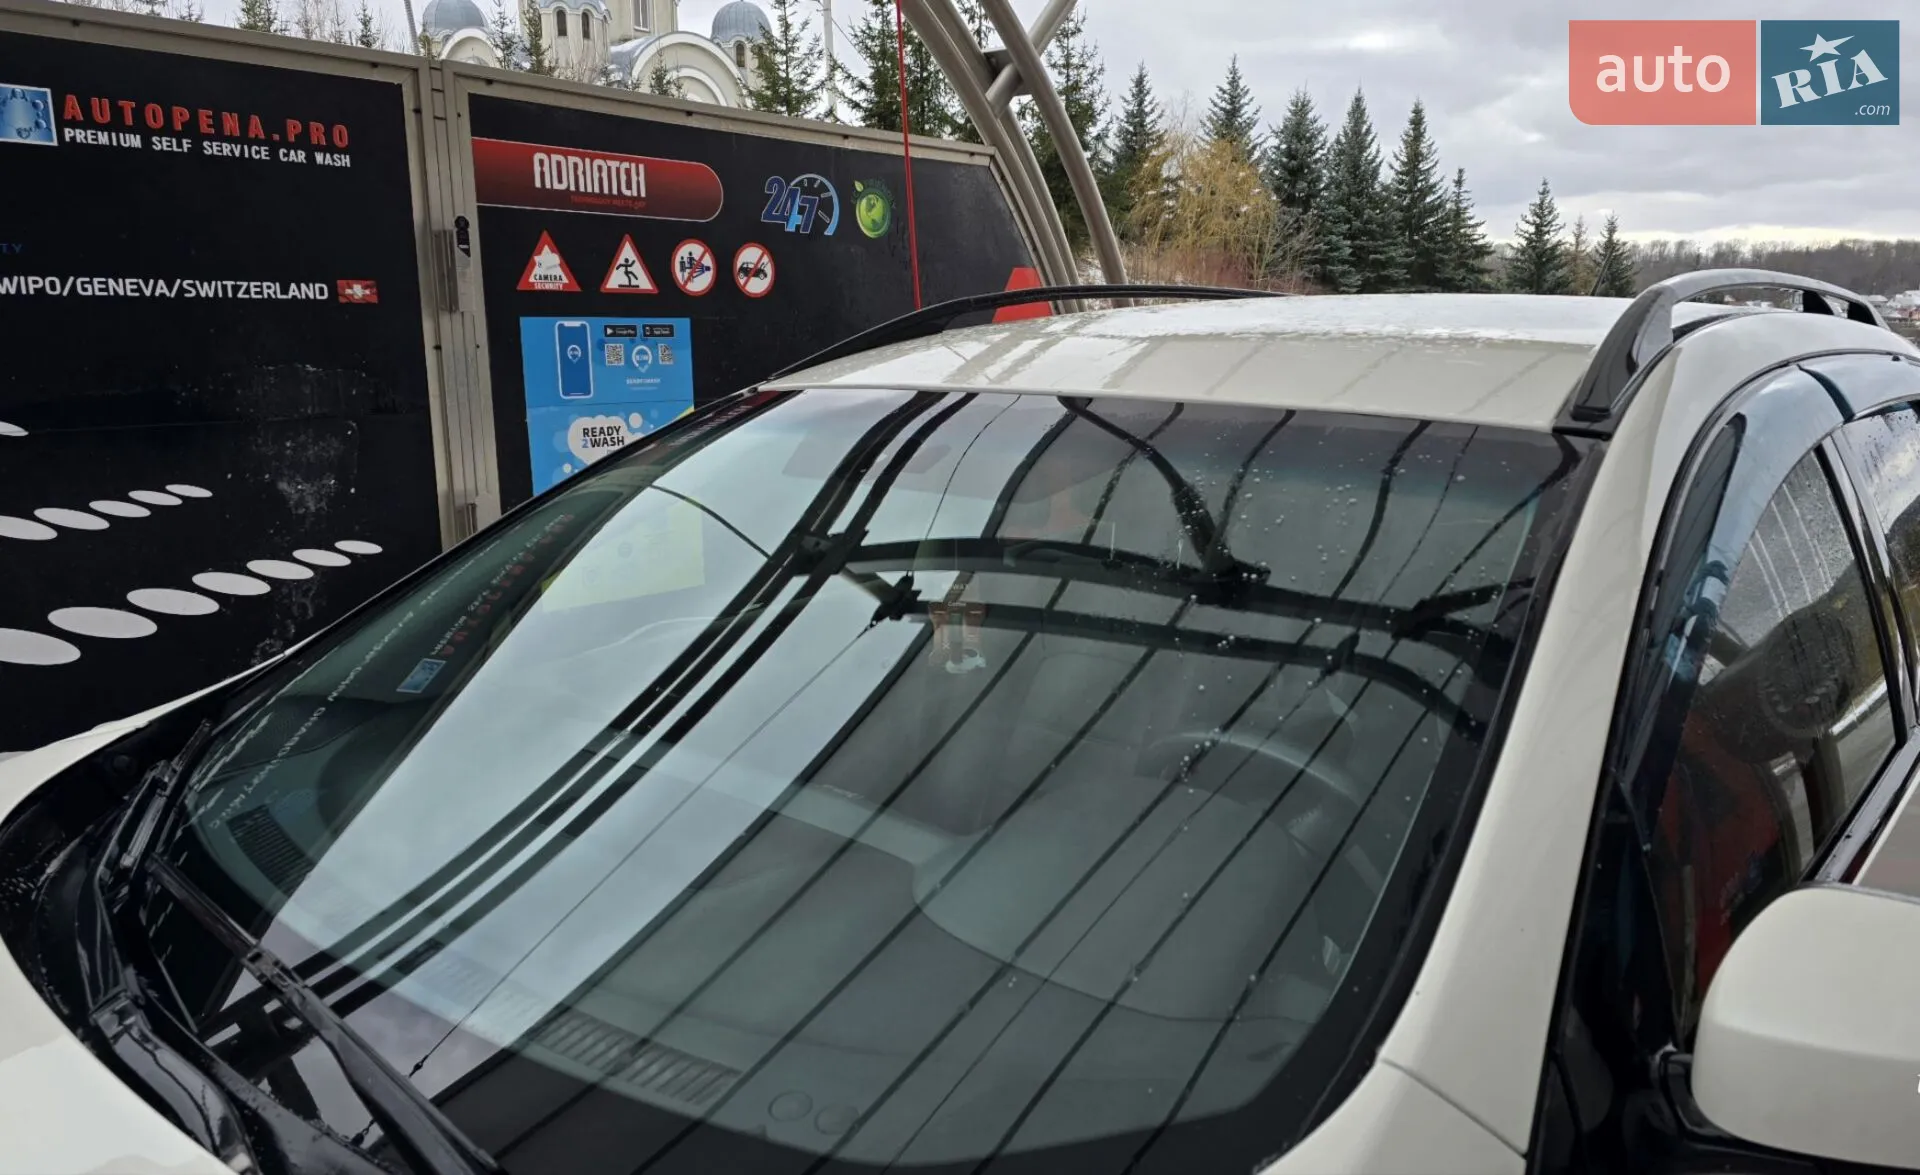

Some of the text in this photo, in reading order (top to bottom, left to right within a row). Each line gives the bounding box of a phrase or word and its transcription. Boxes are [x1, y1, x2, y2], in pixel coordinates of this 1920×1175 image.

[63, 93, 350, 149] AUTOPENA.PRO
[64, 127, 351, 168] PREMIUM SELF SERVICE CAR WASH
[582, 425, 622, 438] READY
